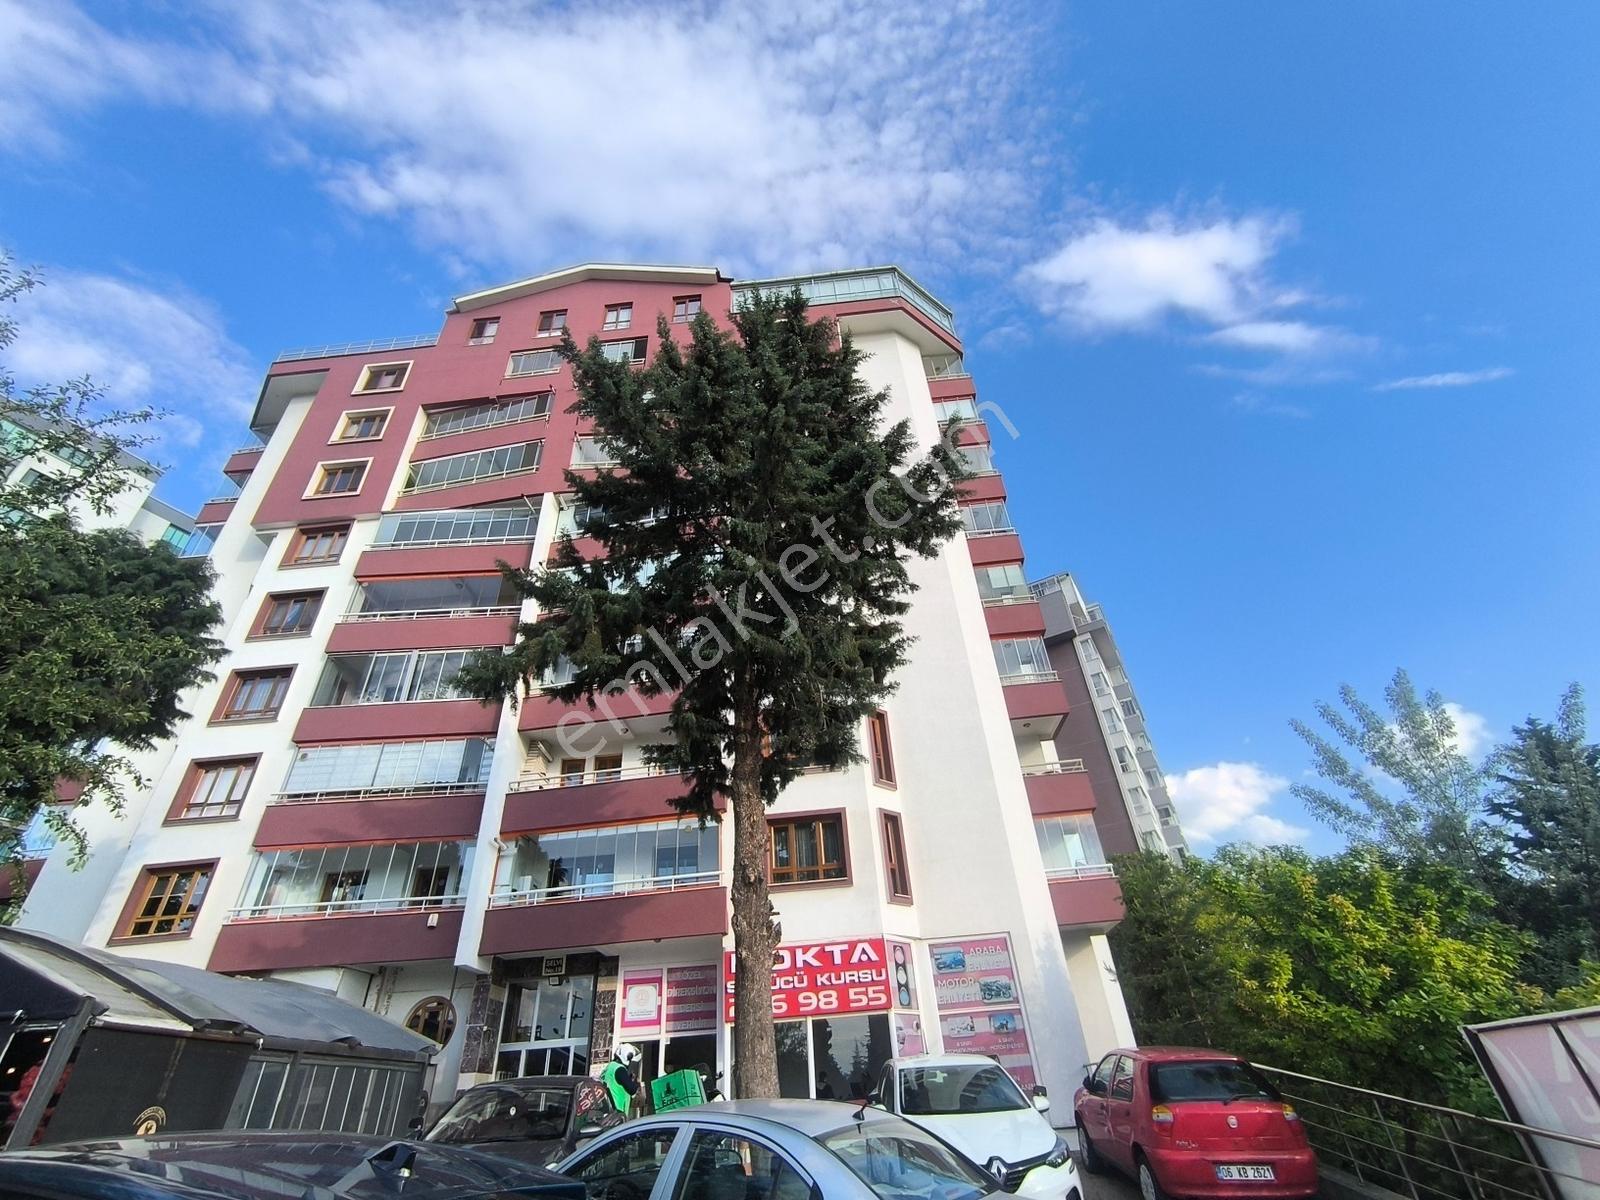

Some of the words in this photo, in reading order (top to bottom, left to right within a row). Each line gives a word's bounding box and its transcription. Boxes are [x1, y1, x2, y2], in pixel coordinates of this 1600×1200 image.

[730, 941, 880, 975] OKTA
[969, 945, 1002, 956] ARABA
[726, 971, 808, 994] SÜCÜ
[816, 968, 887, 986] KURSU
[937, 976, 975, 989] MOTOR
[798, 989, 839, 1012] 98
[848, 985, 888, 1007] 55
[1221, 1167, 1233, 1178] 06
